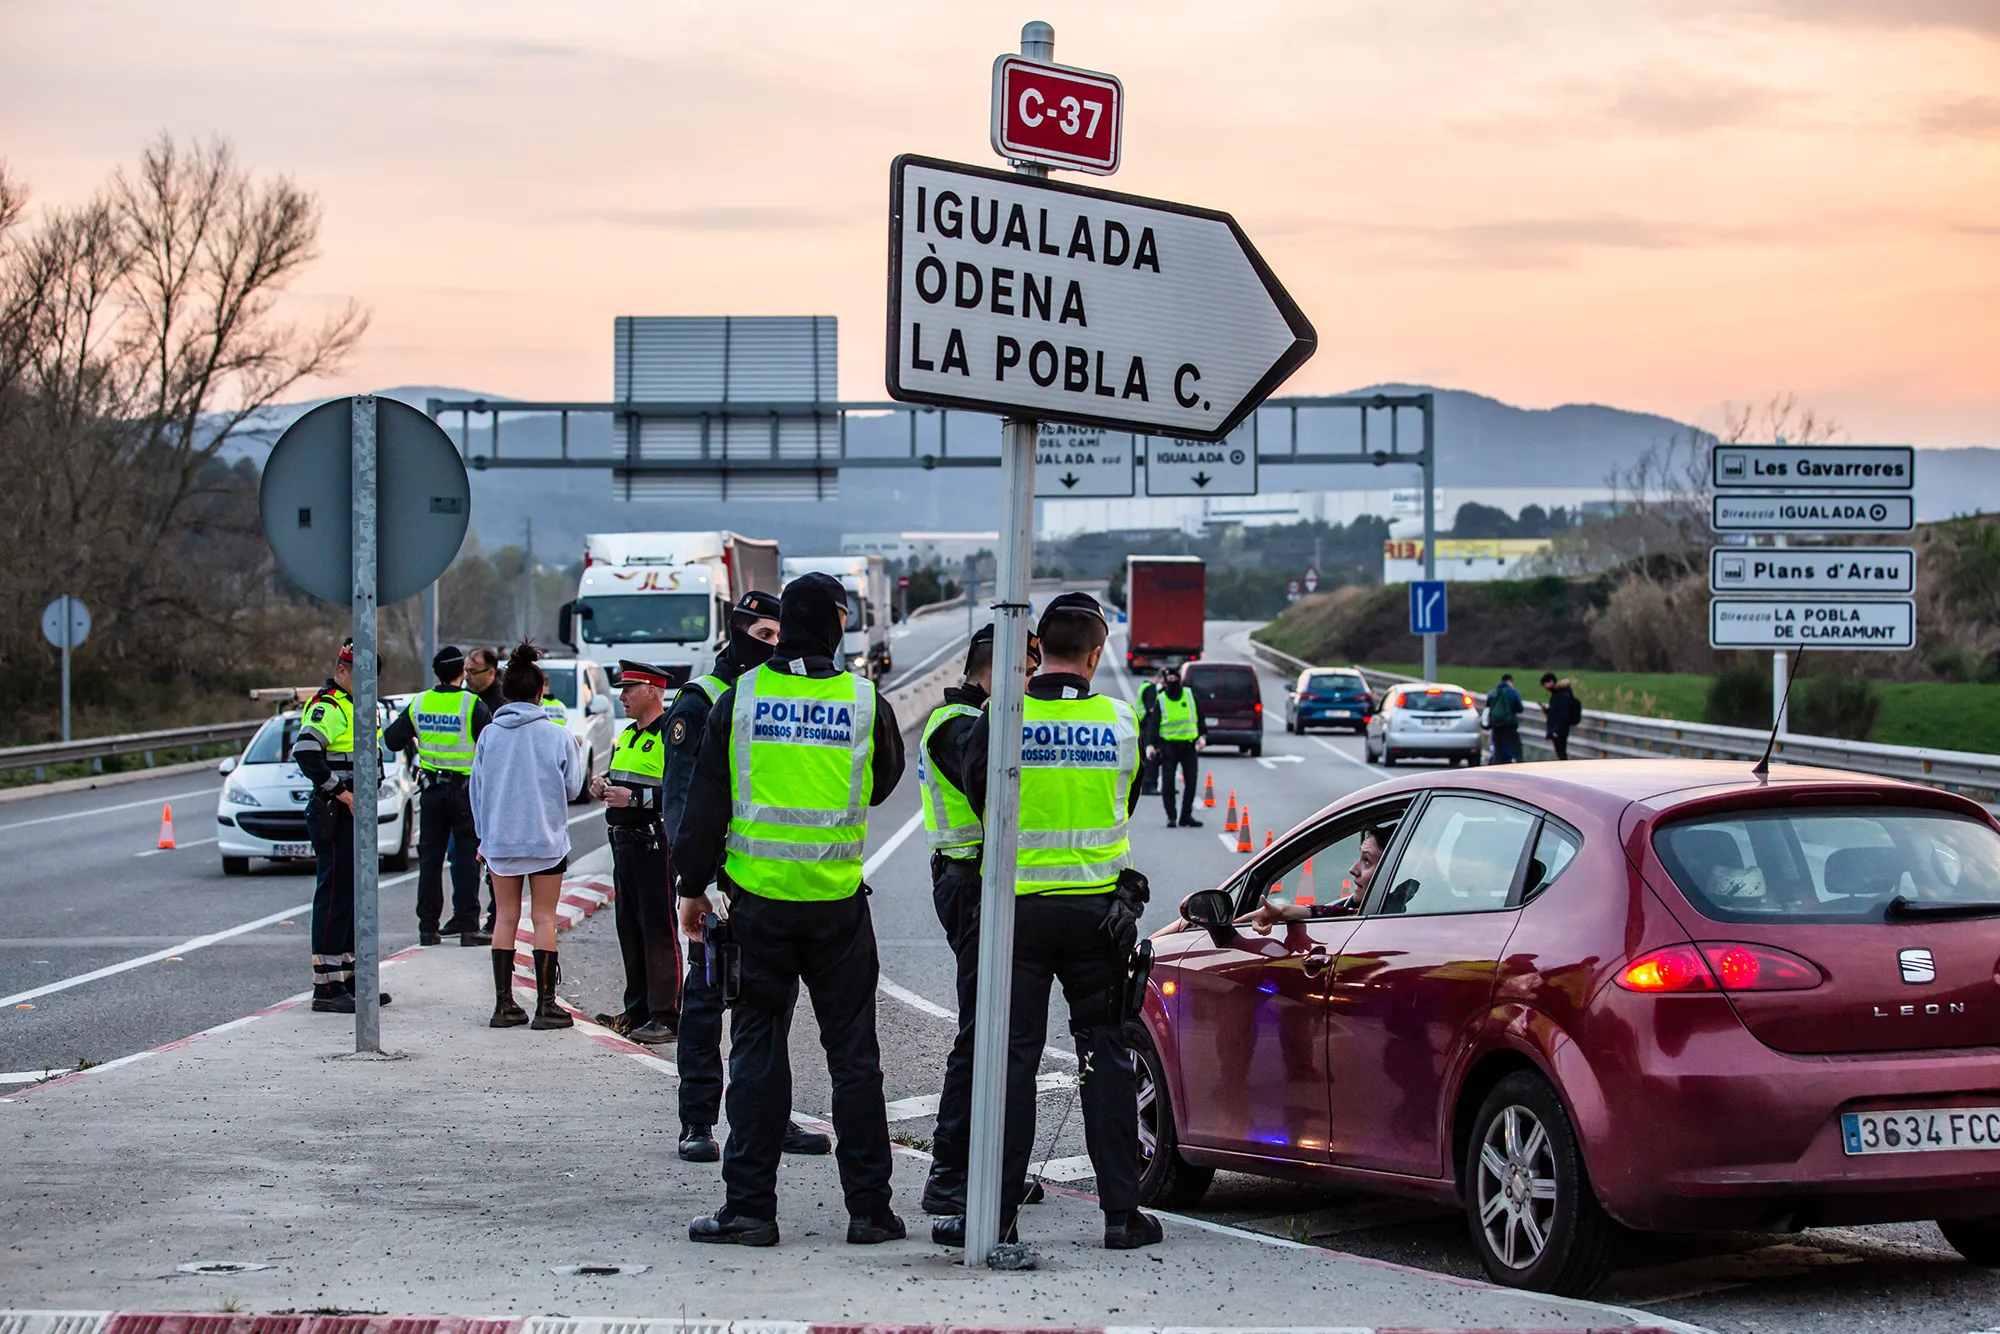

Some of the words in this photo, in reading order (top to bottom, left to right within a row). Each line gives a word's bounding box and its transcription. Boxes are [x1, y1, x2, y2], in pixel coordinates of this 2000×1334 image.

[1018, 87, 1103, 139] C-37
[916, 186, 1161, 273] IGUALADA
[915, 243, 1088, 328] ÒDENA
[911, 322, 971, 377] LA
[995, 335, 1150, 402] POBLA
[1173, 362, 1212, 411] C.
[1039, 438, 1063, 448] DEL
[1035, 453, 1095, 464] UALADA
[1157, 452, 1225, 464] IGUALADA
[1754, 459, 1788, 476] Les
[1796, 459, 1905, 477] Gavarreres
[1779, 506, 1866, 519] IGUALADA
[1754, 562, 1815, 580] Plans
[1826, 562, 1899, 580] d'Arau
[636, 571, 683, 591] JLS
[1774, 609, 1796, 621] LA
[1804, 608, 1861, 622] POBLA
[1774, 625, 1794, 638] DE
[1800, 625, 1896, 639] CLARAMUNT
[417, 713, 461, 725] POLICIA
[755, 702, 851, 727] POLICIA
[754, 724, 792, 738] MOSSOS
[796, 727, 851, 742] D'ESQUADRA
[1021, 725, 1117, 746] POLICIA
[1060, 748, 1117, 762] D'ESQUADRA
[1873, 1002, 1964, 1017] LEON
[1862, 1115, 1942, 1148] 3634
[1949, 1113, 2000, 1144] FCC
